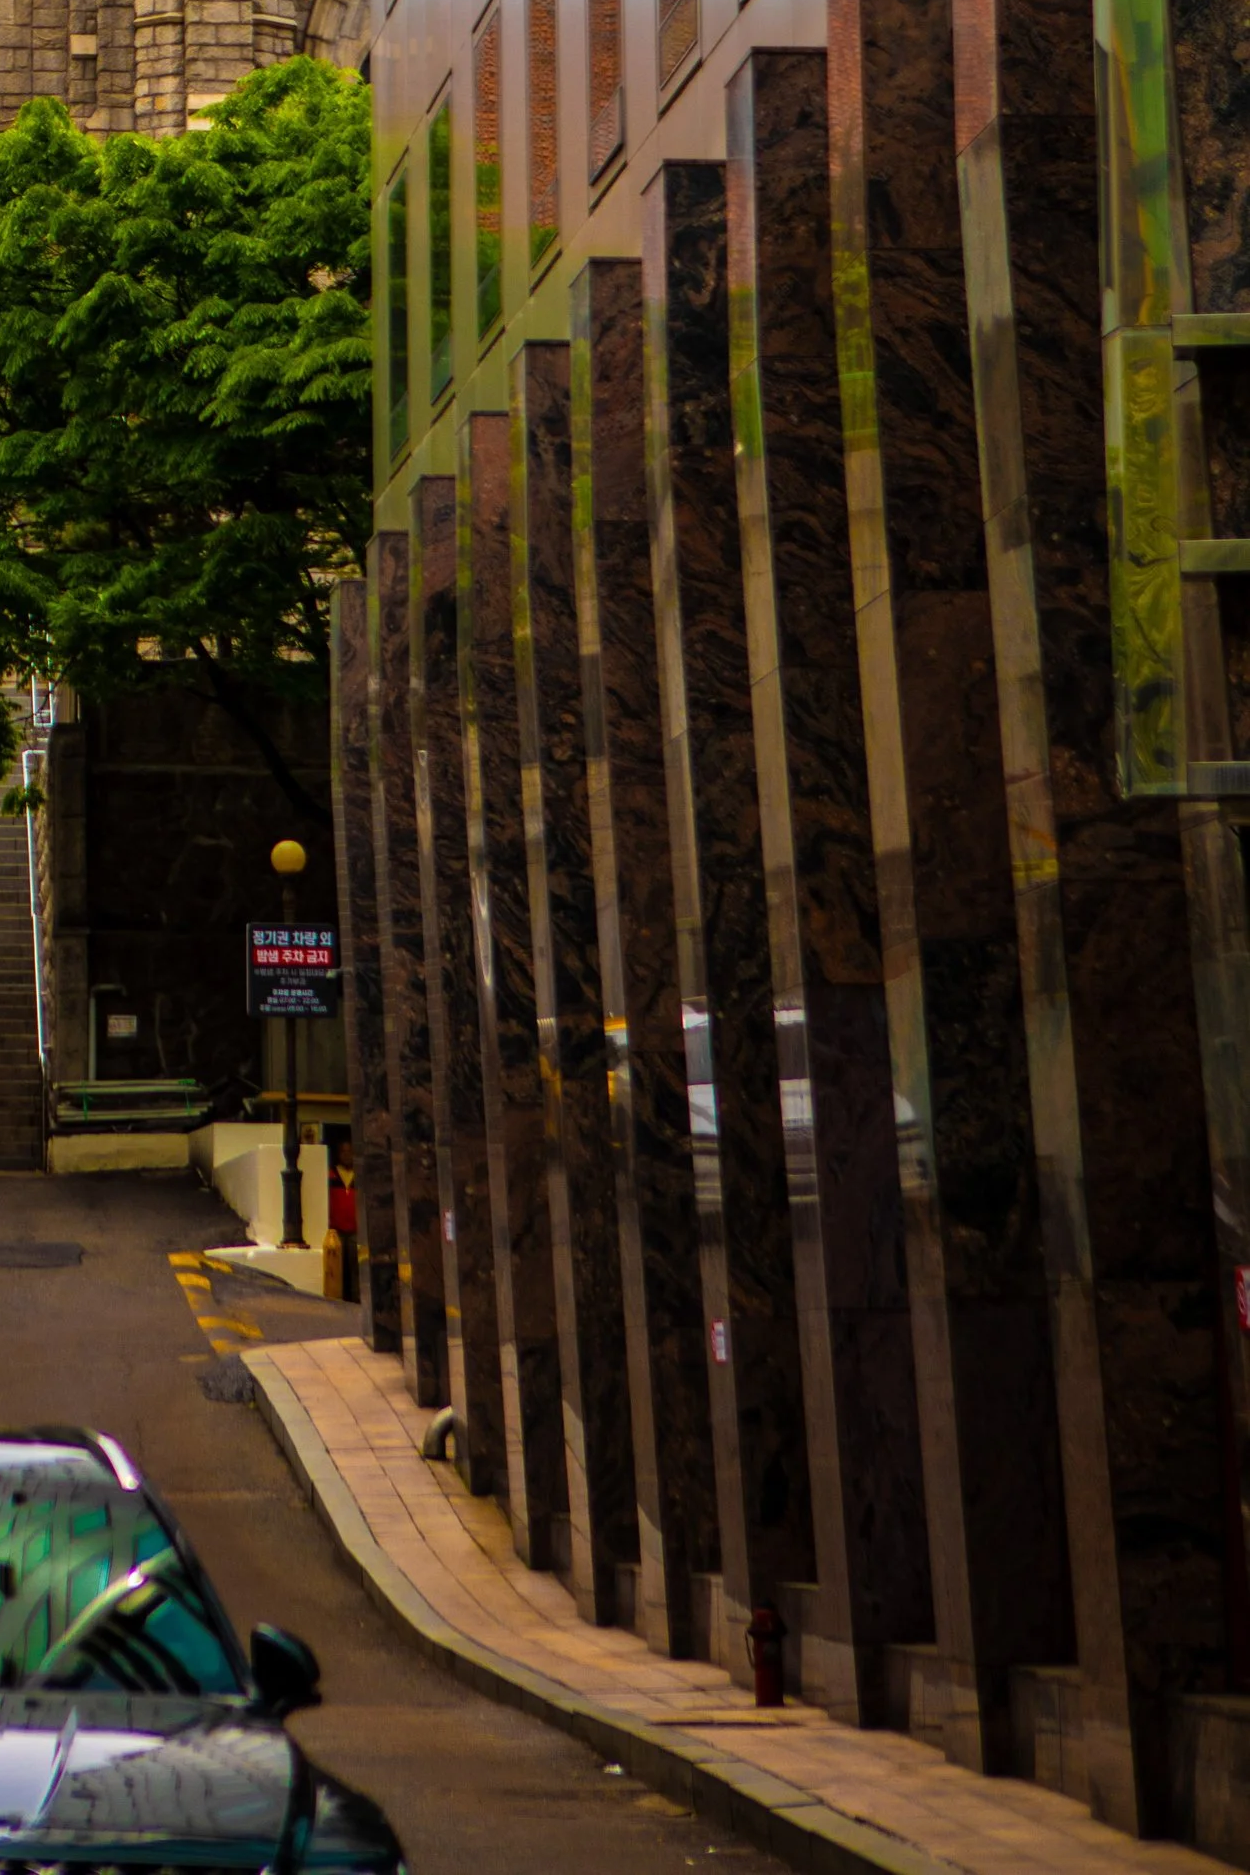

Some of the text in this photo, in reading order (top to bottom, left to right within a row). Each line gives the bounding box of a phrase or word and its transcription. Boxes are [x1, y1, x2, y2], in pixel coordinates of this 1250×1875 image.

[252, 930, 332, 946] 정기권 차량 외
[256, 949, 328, 963] 밤샘 주차 금지
